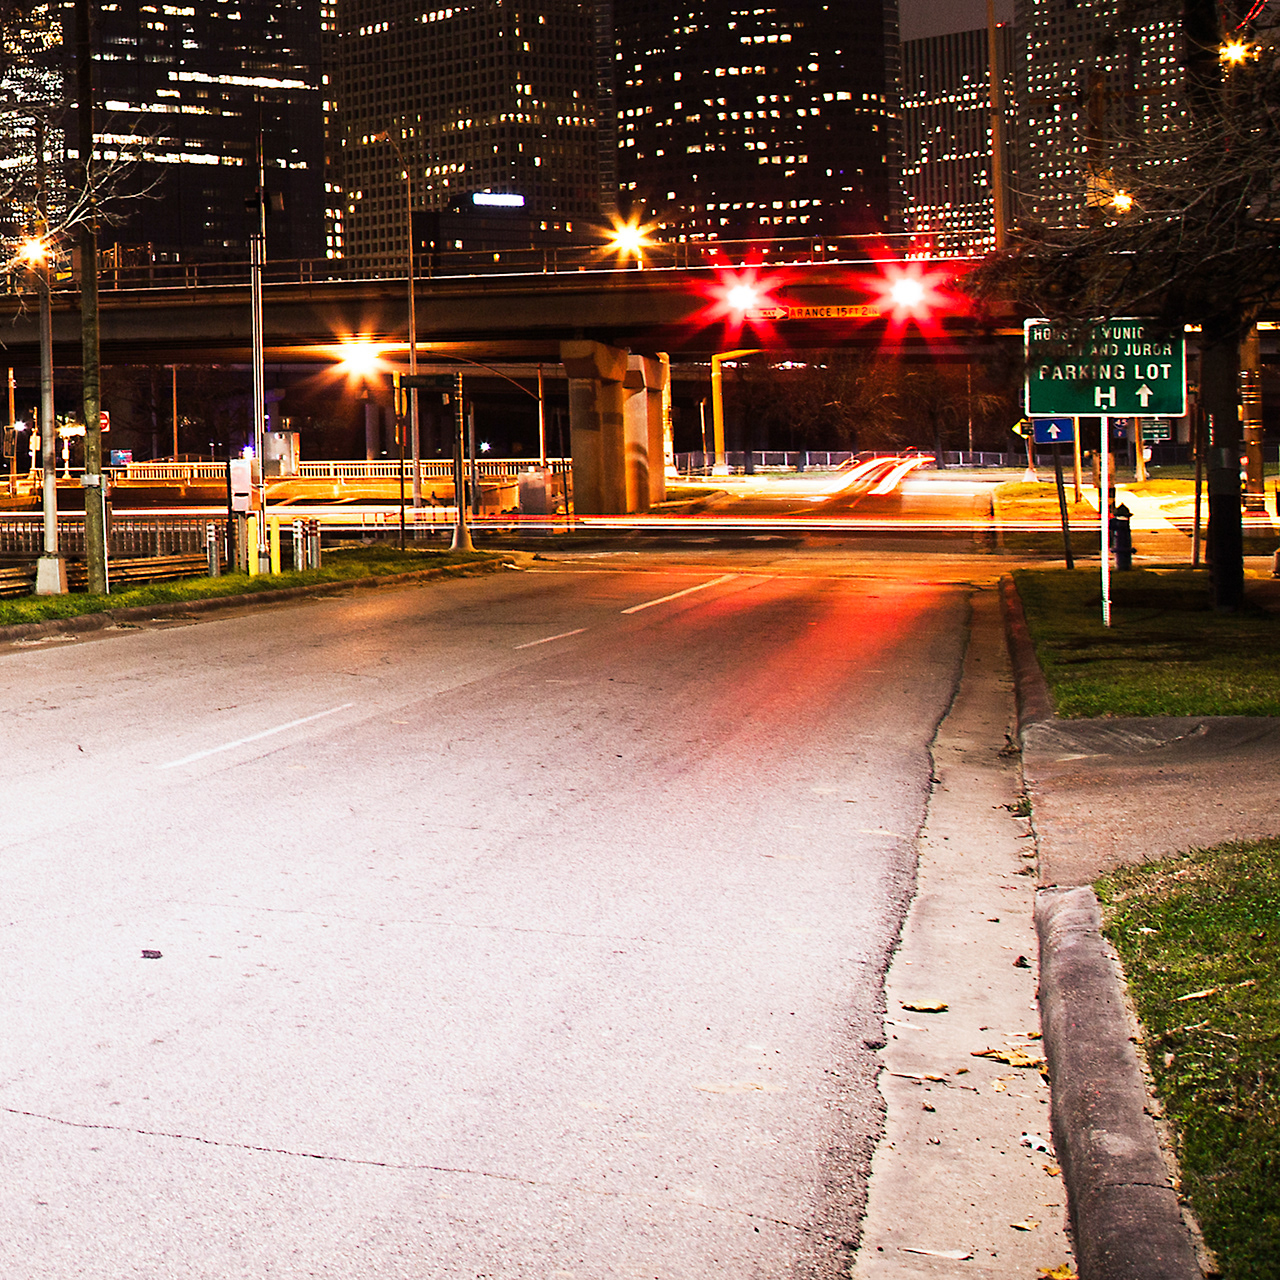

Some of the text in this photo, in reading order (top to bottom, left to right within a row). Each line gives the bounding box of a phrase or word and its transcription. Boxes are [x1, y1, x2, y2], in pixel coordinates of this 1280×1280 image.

[1090, 343, 1119, 356] AND
[1124, 343, 1172, 356] JUROR
[1039, 363, 1172, 380] PARKING LOT
[1094, 386, 1116, 407] H
